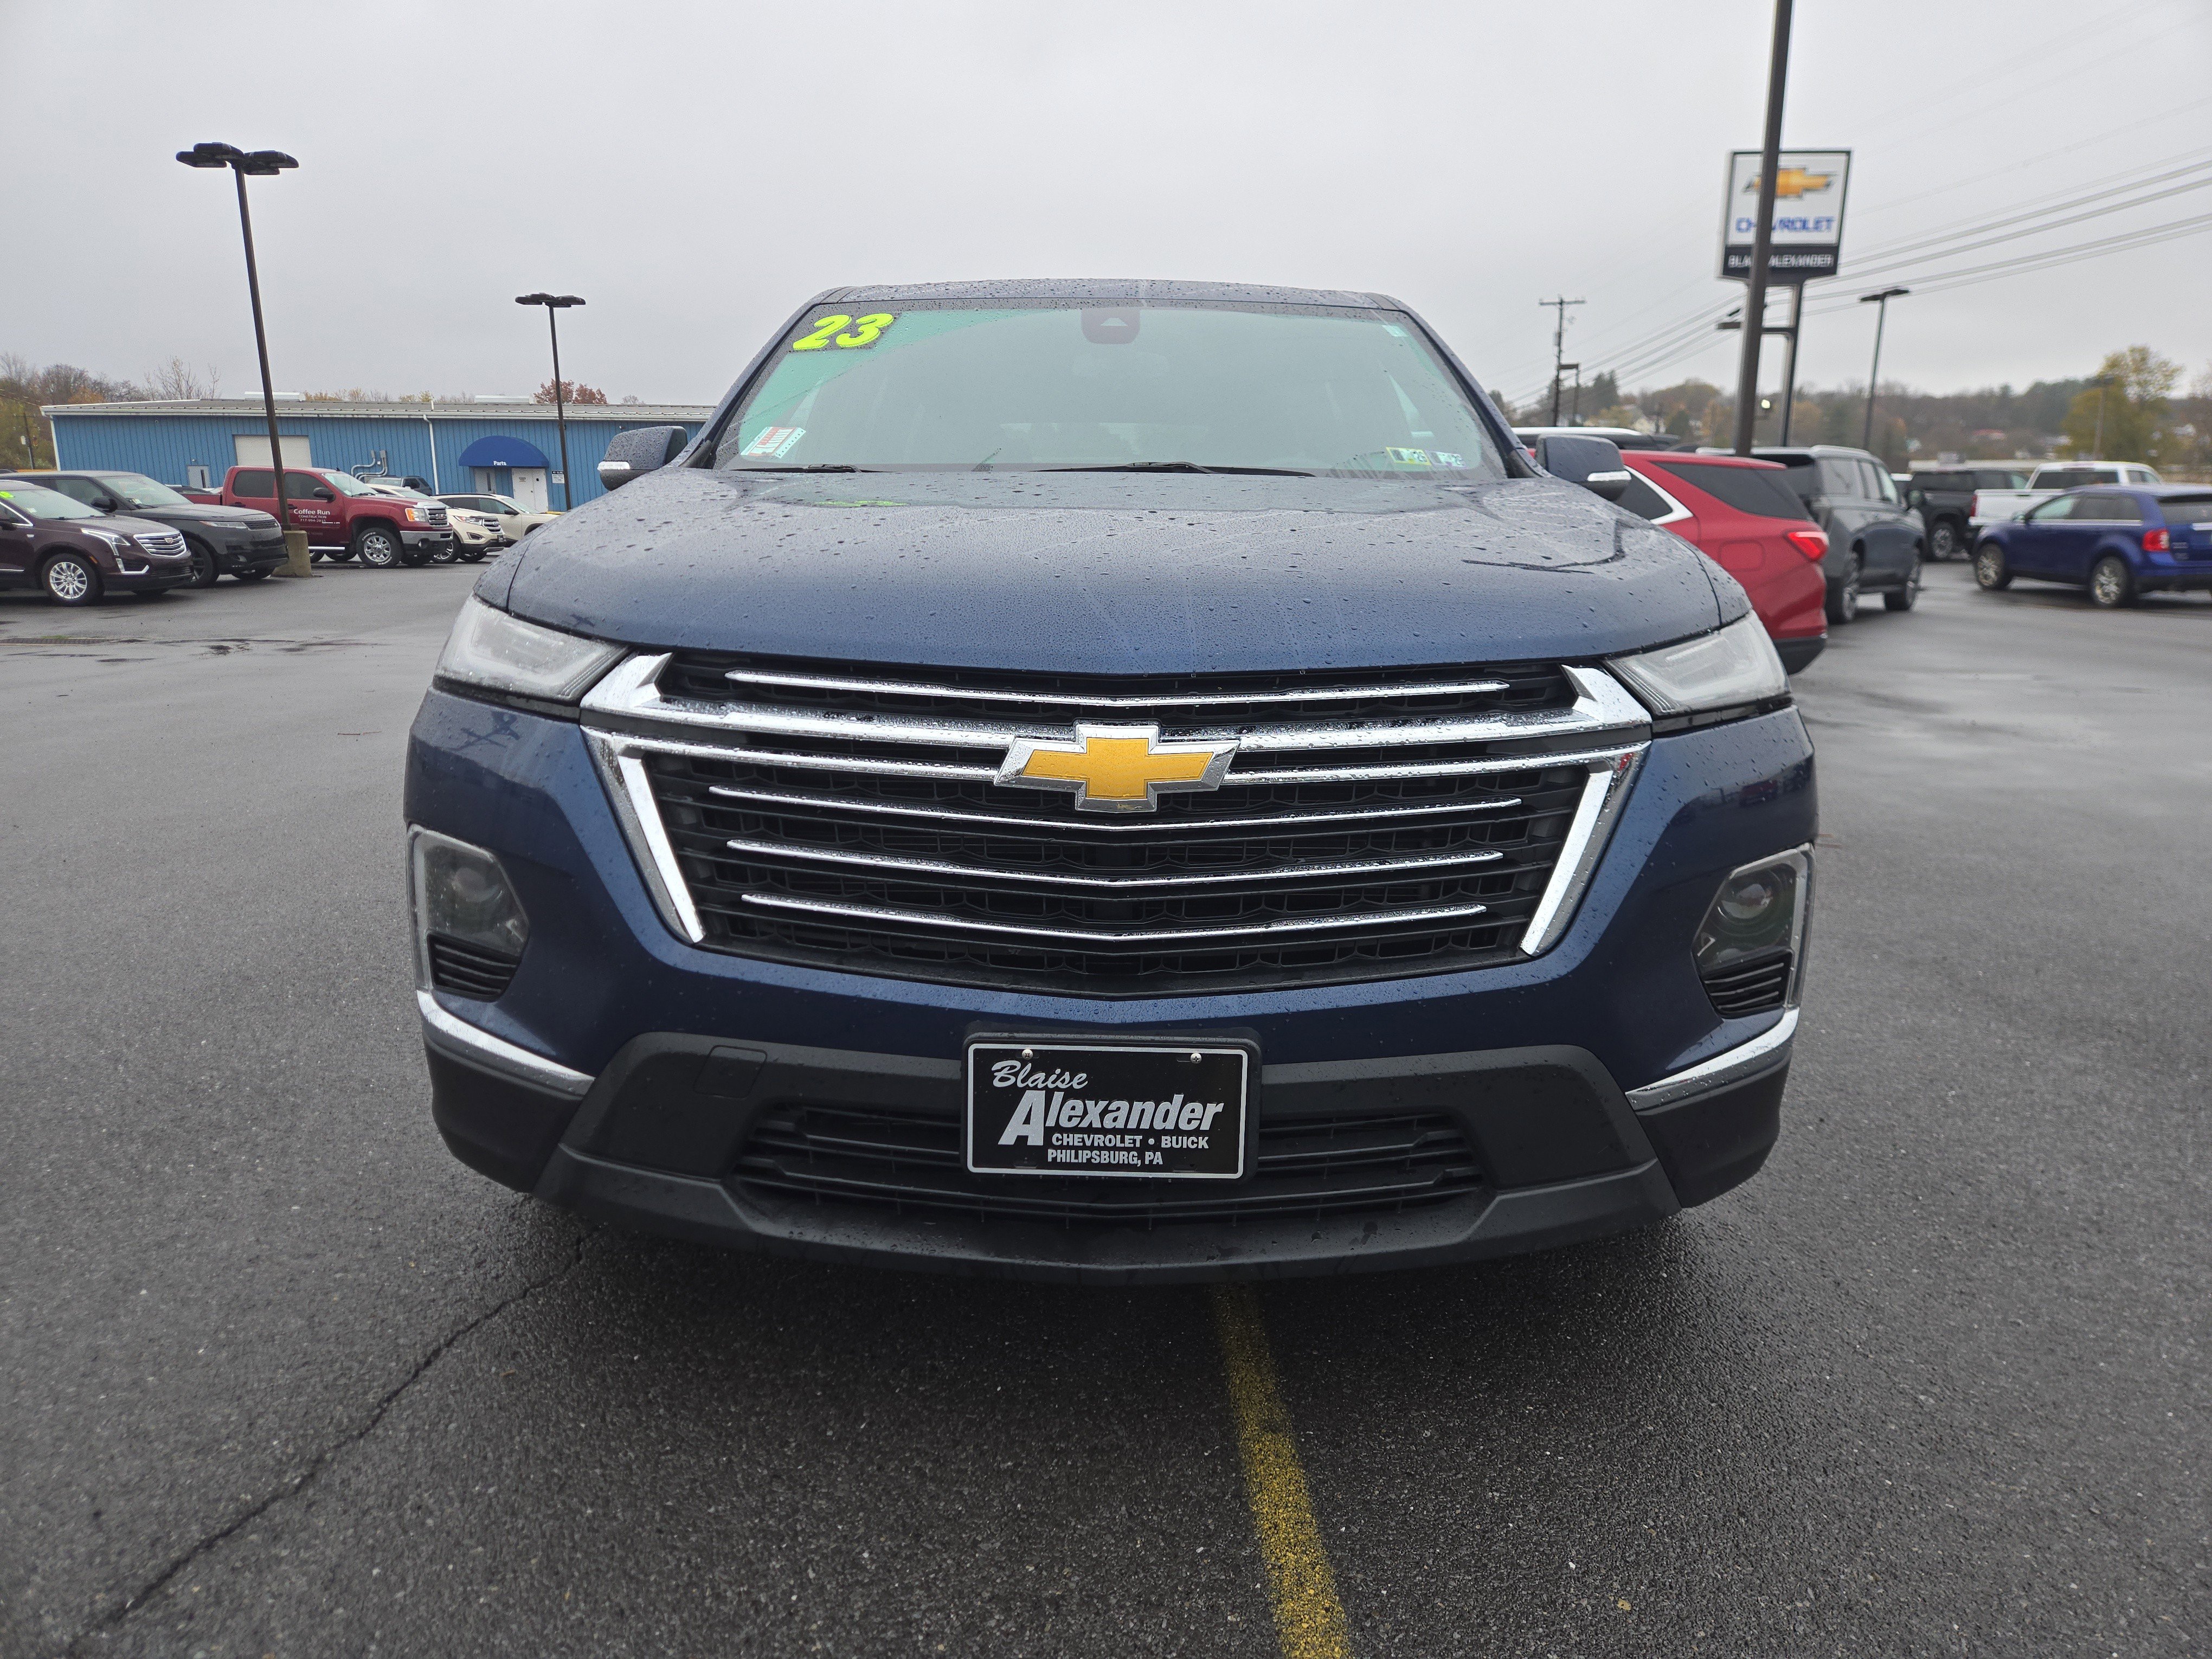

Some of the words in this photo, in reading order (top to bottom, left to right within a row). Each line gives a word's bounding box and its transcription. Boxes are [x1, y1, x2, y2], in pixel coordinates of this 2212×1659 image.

[1768, 254, 1835, 268] ALEXANDER
[793, 313, 893, 350] 23
[992, 1060, 1088, 1090] Blaise
[998, 1090, 1224, 1146] Alexander
[1052, 1133, 1143, 1148] CHEVROLET
[1161, 1136, 1209, 1149] BUICK
[1047, 1149, 1142, 1167] PHILIPSBURG,
[1144, 1151, 1163, 1165] PA
